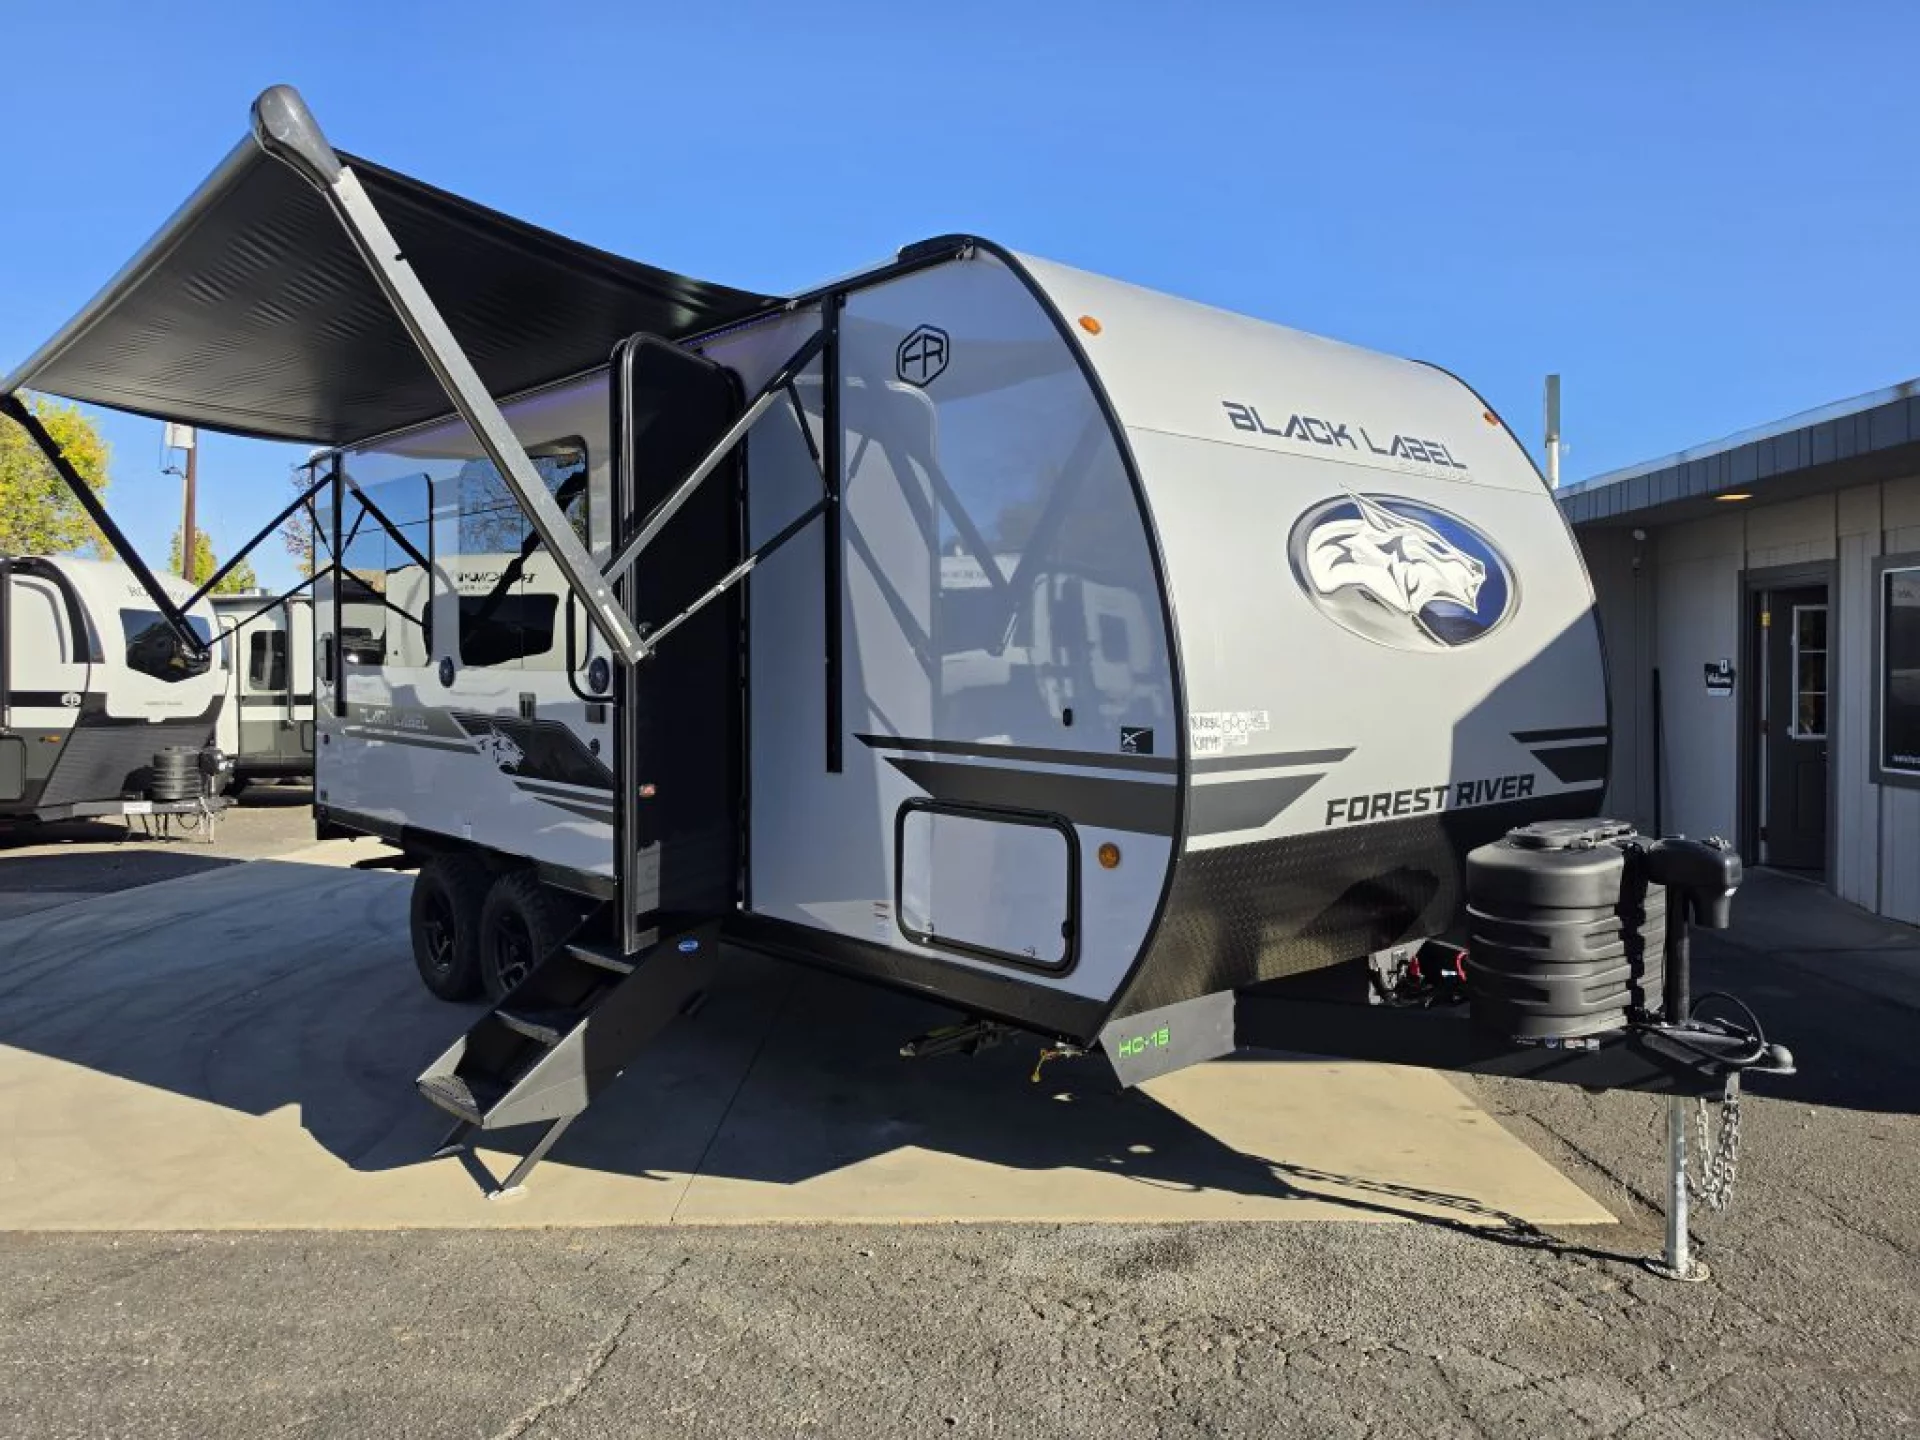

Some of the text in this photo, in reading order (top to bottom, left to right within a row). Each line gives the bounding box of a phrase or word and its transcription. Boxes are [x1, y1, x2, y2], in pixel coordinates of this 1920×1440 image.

[1222, 400, 1467, 470] BLACK LABEL
[1325, 773, 1535, 826] FOREST RIVER
